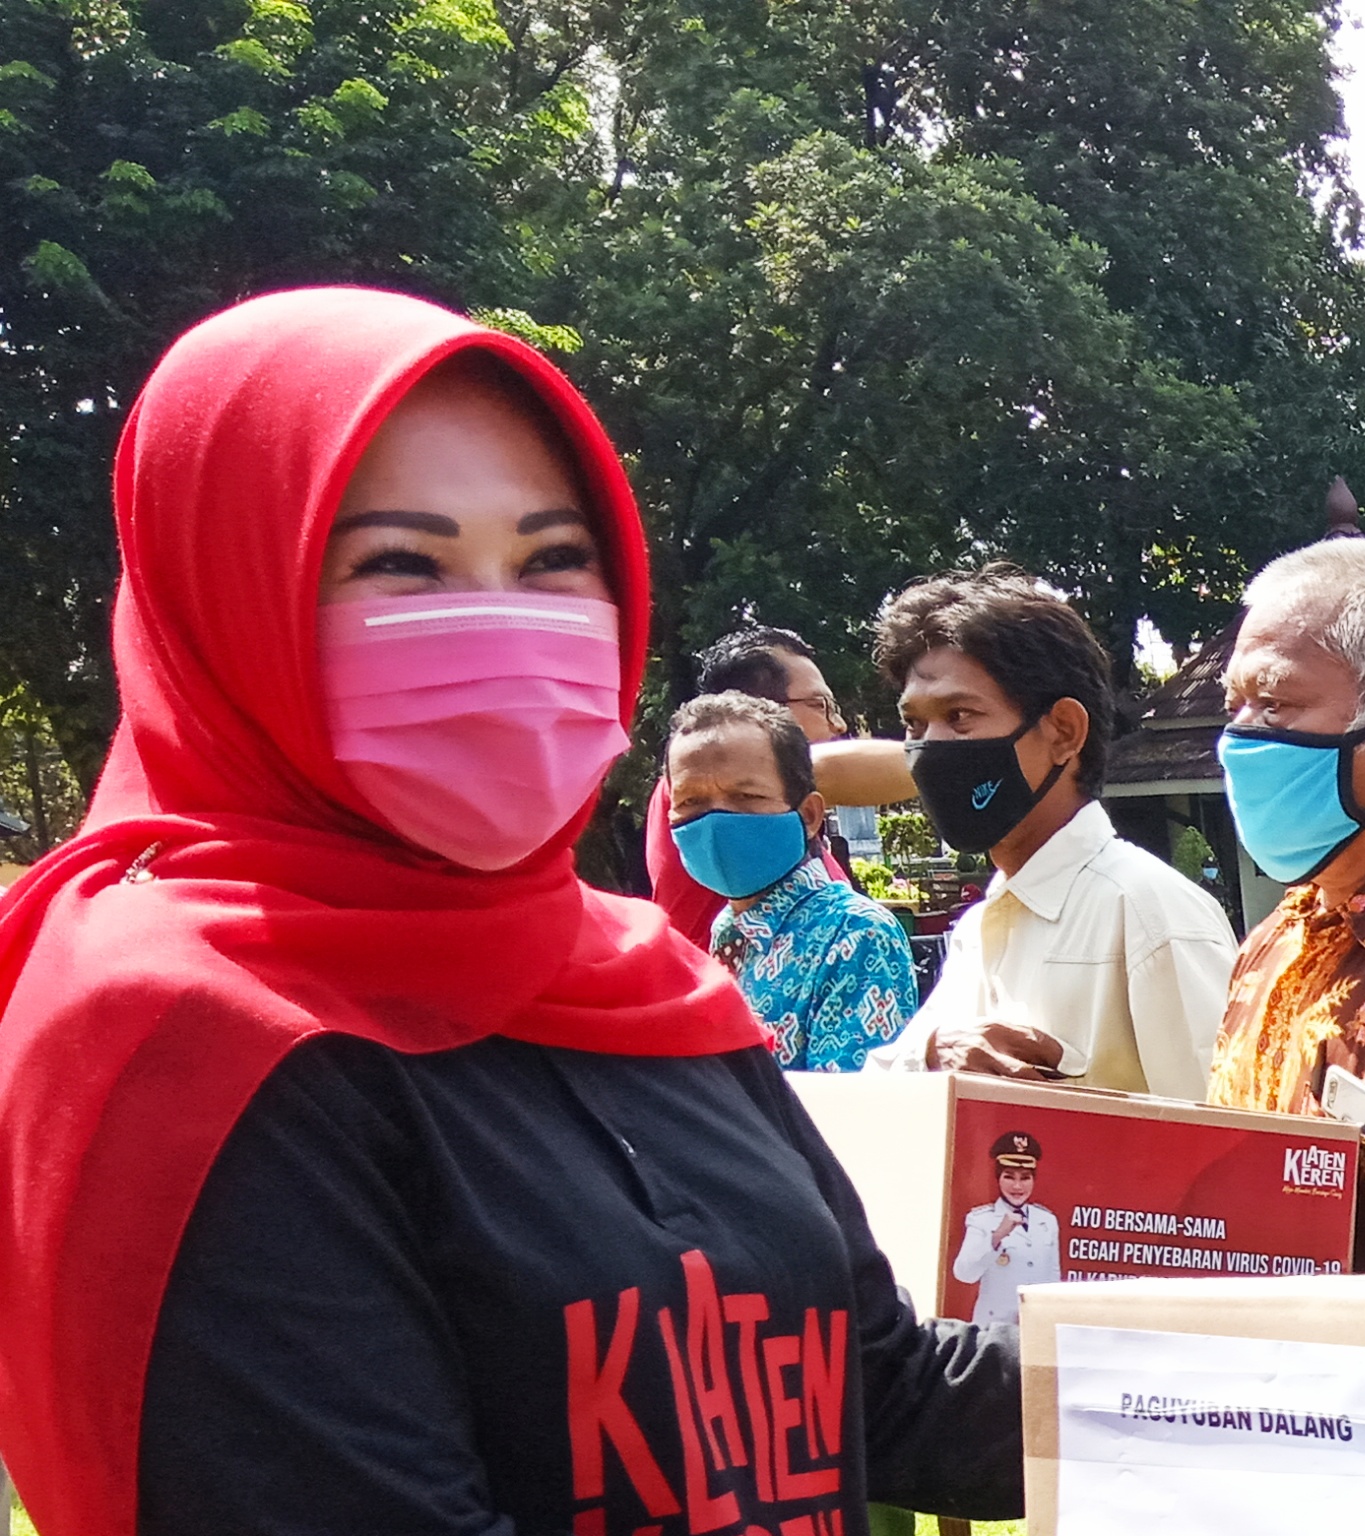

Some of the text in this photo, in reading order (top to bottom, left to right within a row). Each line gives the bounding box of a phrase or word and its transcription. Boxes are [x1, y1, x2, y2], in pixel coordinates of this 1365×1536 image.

[973, 780, 996, 800] NIKE
[1071, 1206, 1226, 1240] AYO BERSAMA-SAMA
[1069, 1238, 1341, 1276] CEGAH PENYEBARAN VIRUS COVID-19
[564, 1249, 848, 1536] KLATEN
[1121, 1392, 1354, 1442] PAGUYUBAN DALANG
